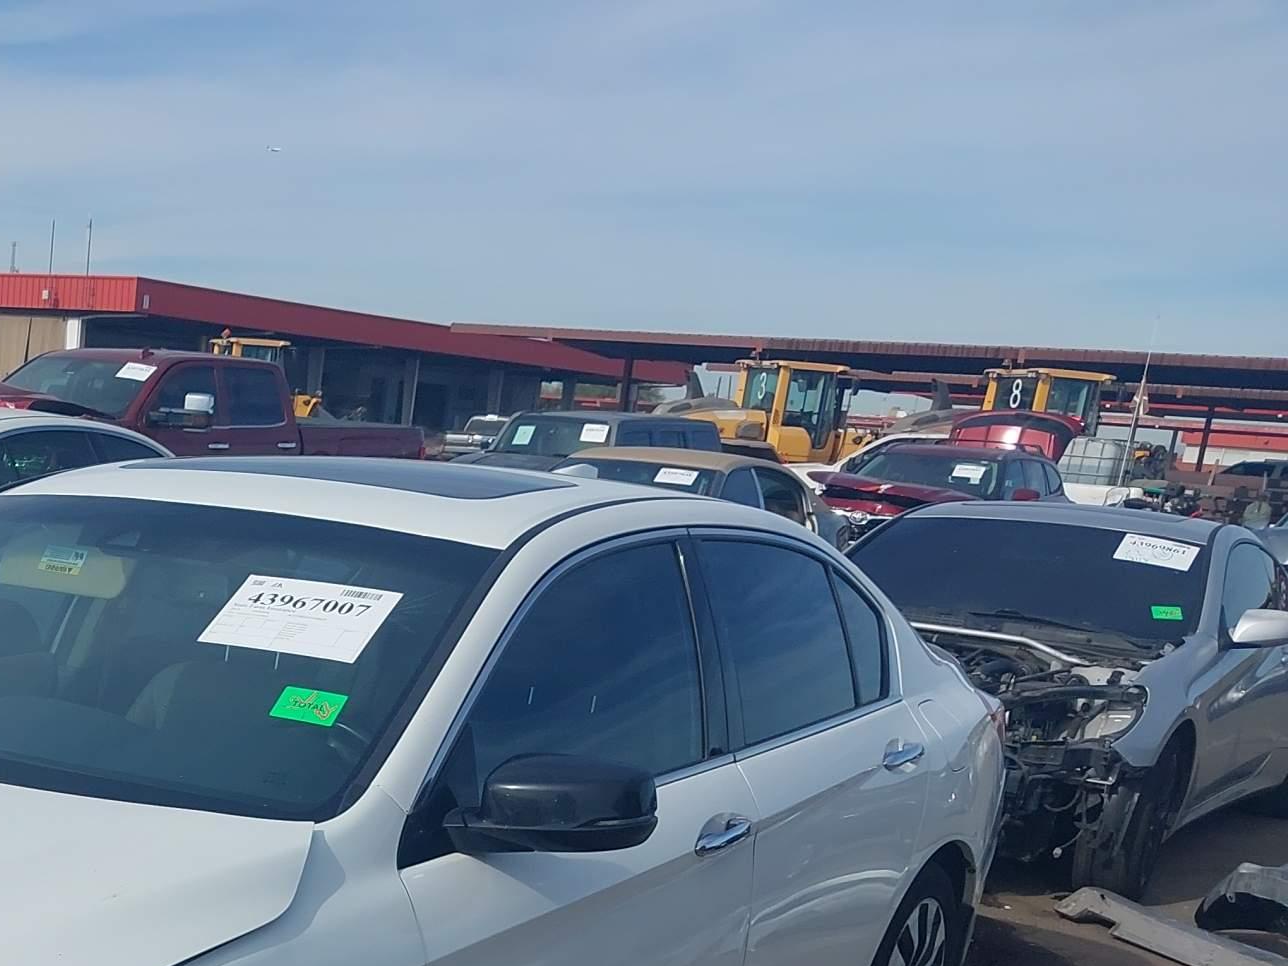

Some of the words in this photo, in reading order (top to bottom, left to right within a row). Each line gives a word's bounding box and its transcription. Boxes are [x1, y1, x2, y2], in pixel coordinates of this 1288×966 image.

[757, 371, 767, 400] 3
[1009, 378, 1023, 409] 8
[247, 592, 372, 617] 43967007
